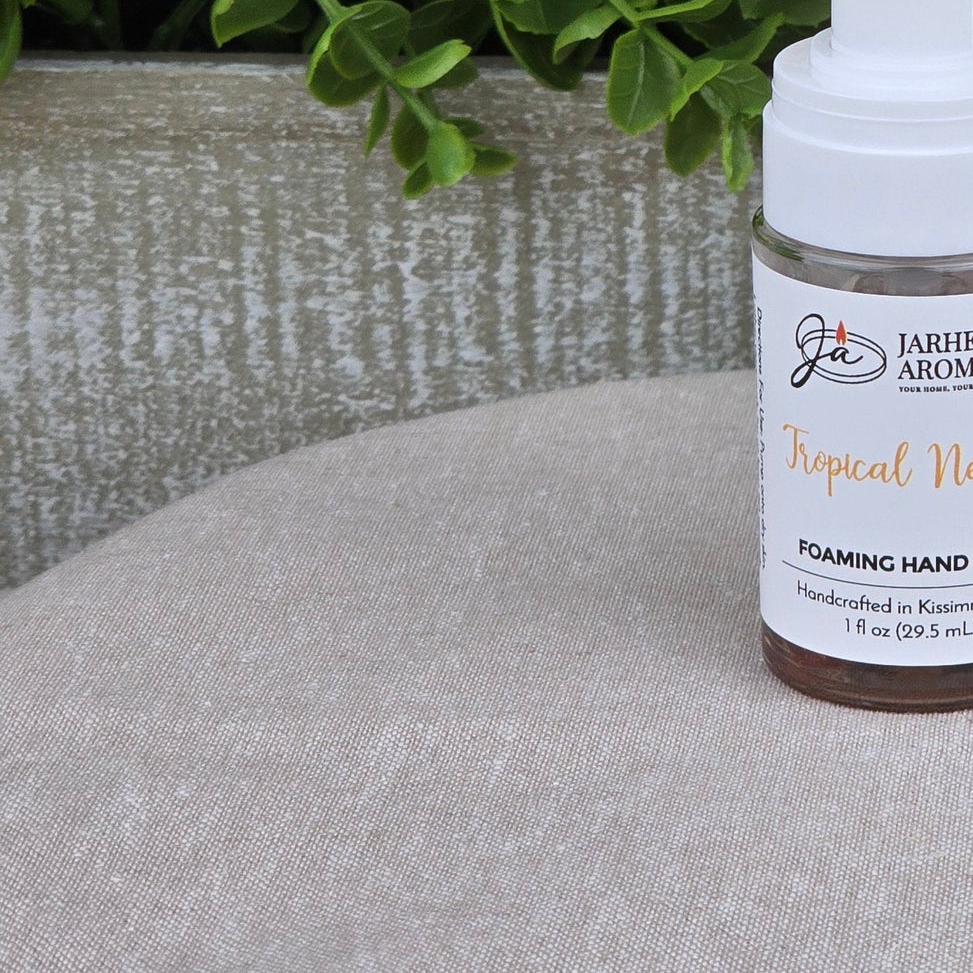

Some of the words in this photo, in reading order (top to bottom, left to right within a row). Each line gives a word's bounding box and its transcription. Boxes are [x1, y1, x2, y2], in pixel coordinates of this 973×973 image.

[898, 385, 922, 393] YOUR
[952, 383, 973, 391] YOUR
[782, 423, 913, 498] Tropical
[799, 538, 895, 572] FOAMING
[901, 554, 969, 573] HAND
[797, 579, 892, 614] Handcrafted
[897, 601, 912, 614] in
[845, 618, 851, 633] 1
[856, 618, 866, 634] fl
[871, 626, 891, 637] oz
[896, 623, 939, 641] (29.5
